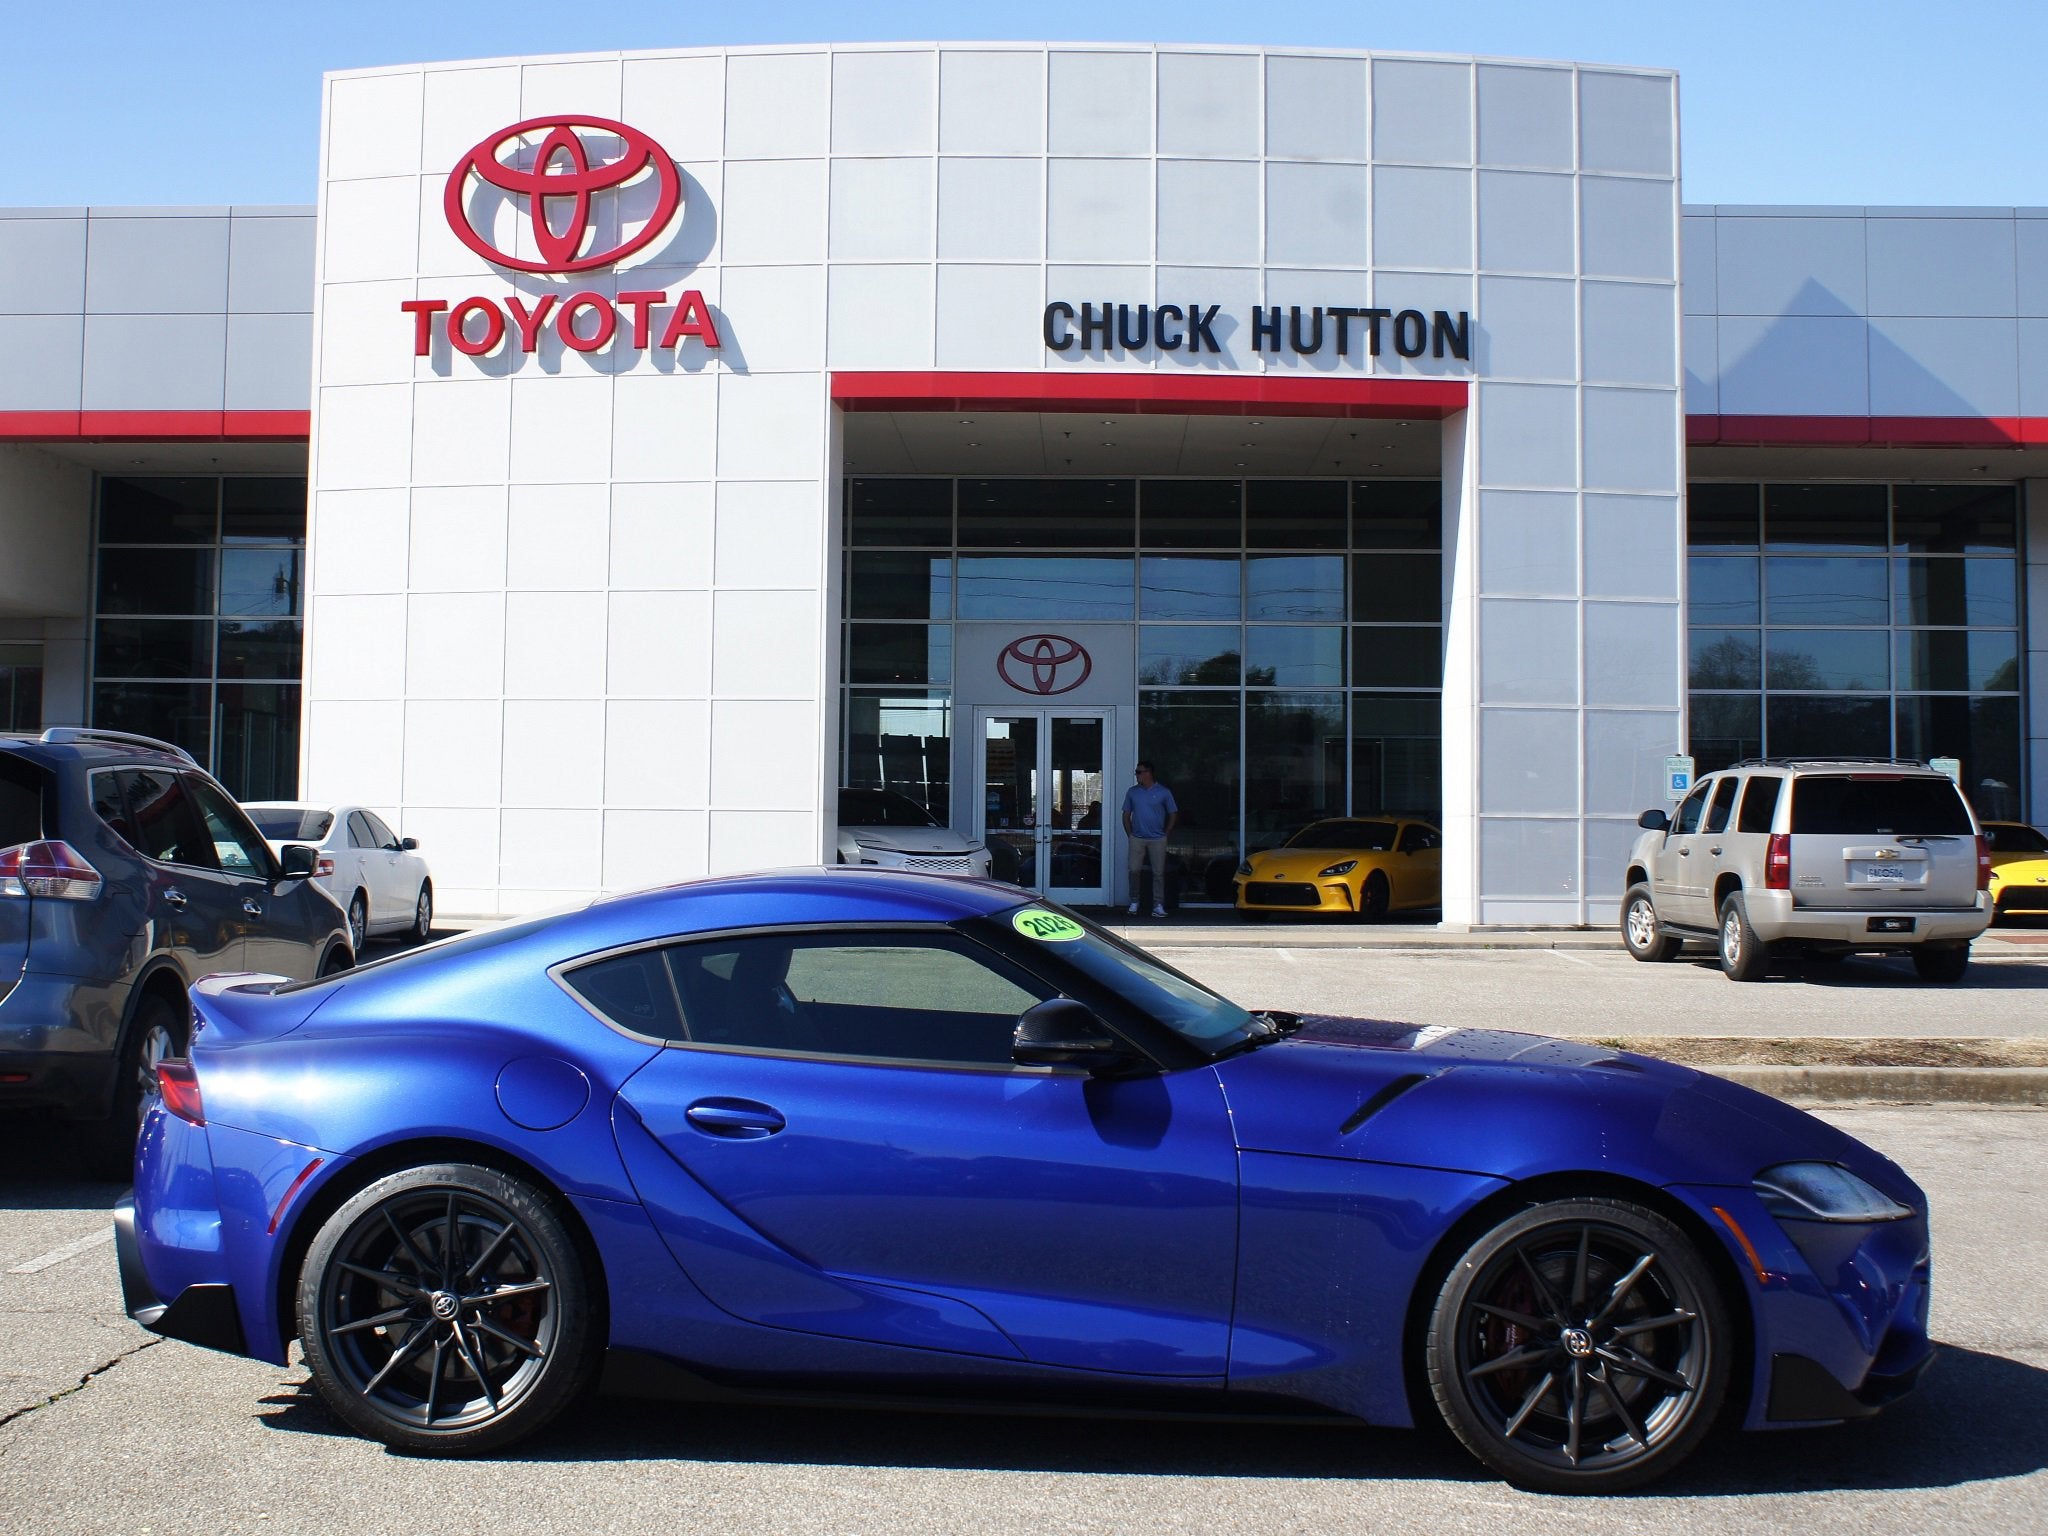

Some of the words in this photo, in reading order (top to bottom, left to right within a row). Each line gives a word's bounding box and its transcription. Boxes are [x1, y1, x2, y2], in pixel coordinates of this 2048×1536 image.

[401, 290, 720, 356] TOYOTA
[1043, 302, 1222, 353] CHUCK
[1252, 305, 1469, 361] HUTTON
[1022, 915, 1077, 936] 2026
